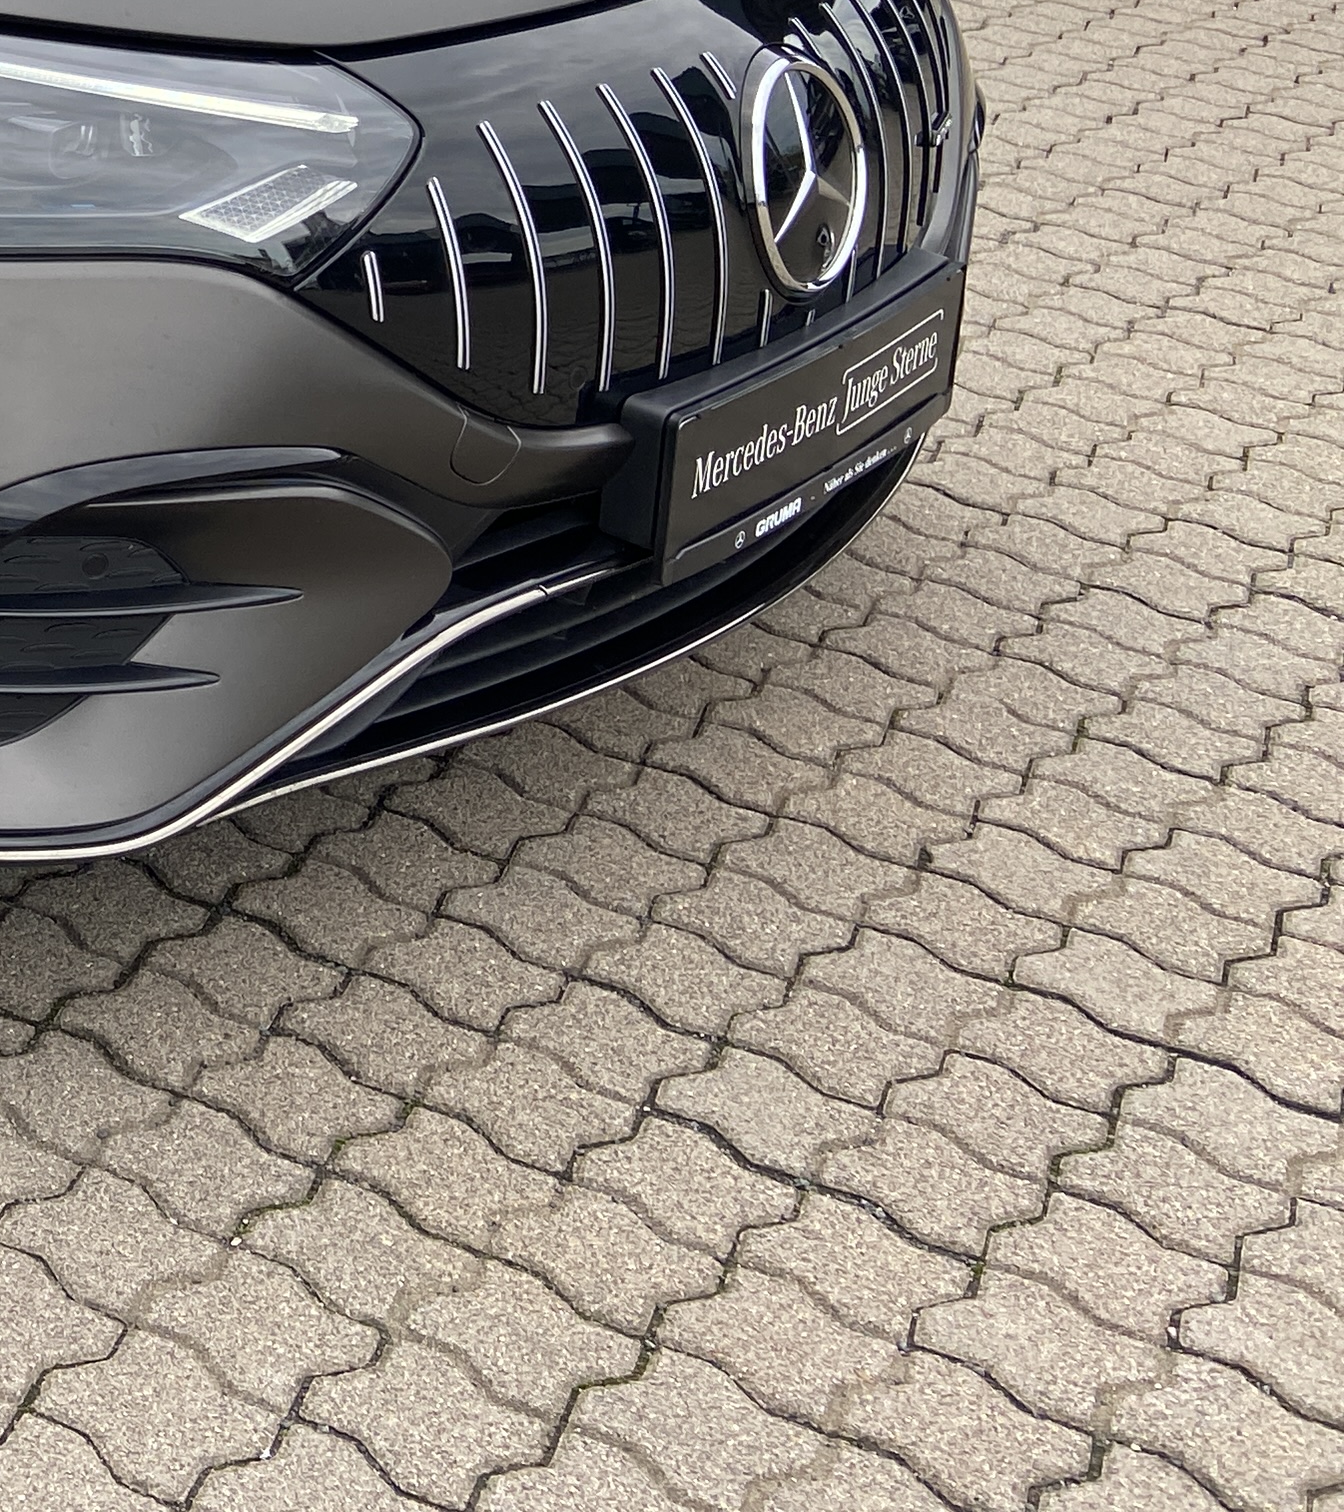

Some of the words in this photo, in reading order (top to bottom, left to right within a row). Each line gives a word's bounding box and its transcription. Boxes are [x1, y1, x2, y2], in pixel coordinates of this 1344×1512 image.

[691, 395, 838, 500] Mercedes-Benz
[841, 366, 889, 425] Junge
[889, 331, 938, 386] Sterne
[754, 496, 803, 538] GRUMA
